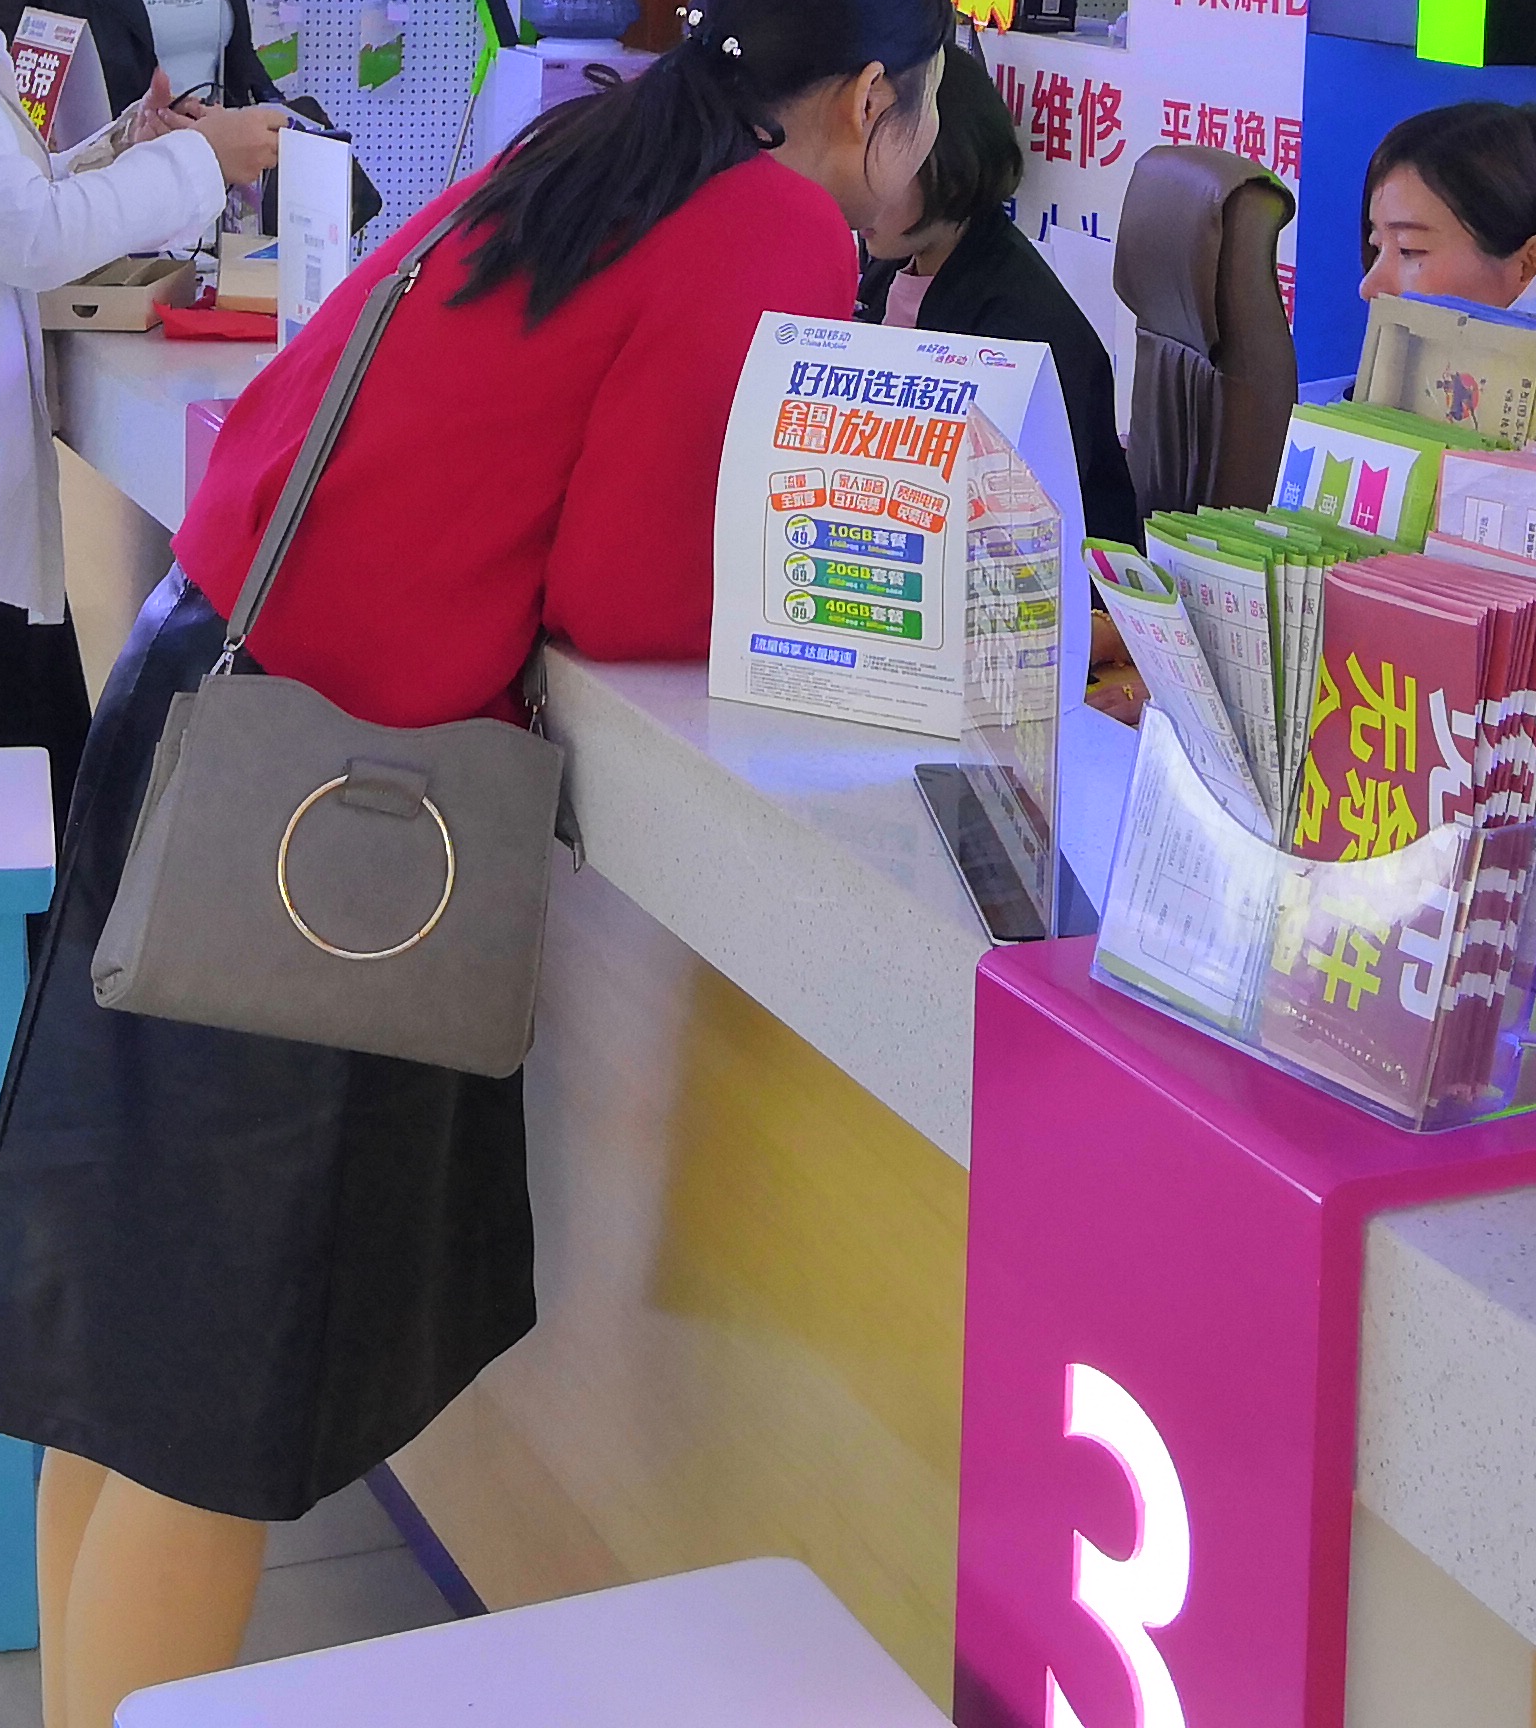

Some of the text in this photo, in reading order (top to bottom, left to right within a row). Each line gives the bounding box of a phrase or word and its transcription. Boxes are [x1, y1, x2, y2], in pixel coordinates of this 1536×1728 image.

[802, 327, 852, 343] 中国移动
[786, 360, 980, 416] 好网选移动
[783, 402, 835, 428] 全国
[831, 408, 967, 485] 放心用
[828, 523, 908, 549] 10GB套餐
[826, 561, 905, 586] 20GB套餐
[825, 599, 905, 625] 40GB套餐
[1045, 1361, 1191, 1728] 3
